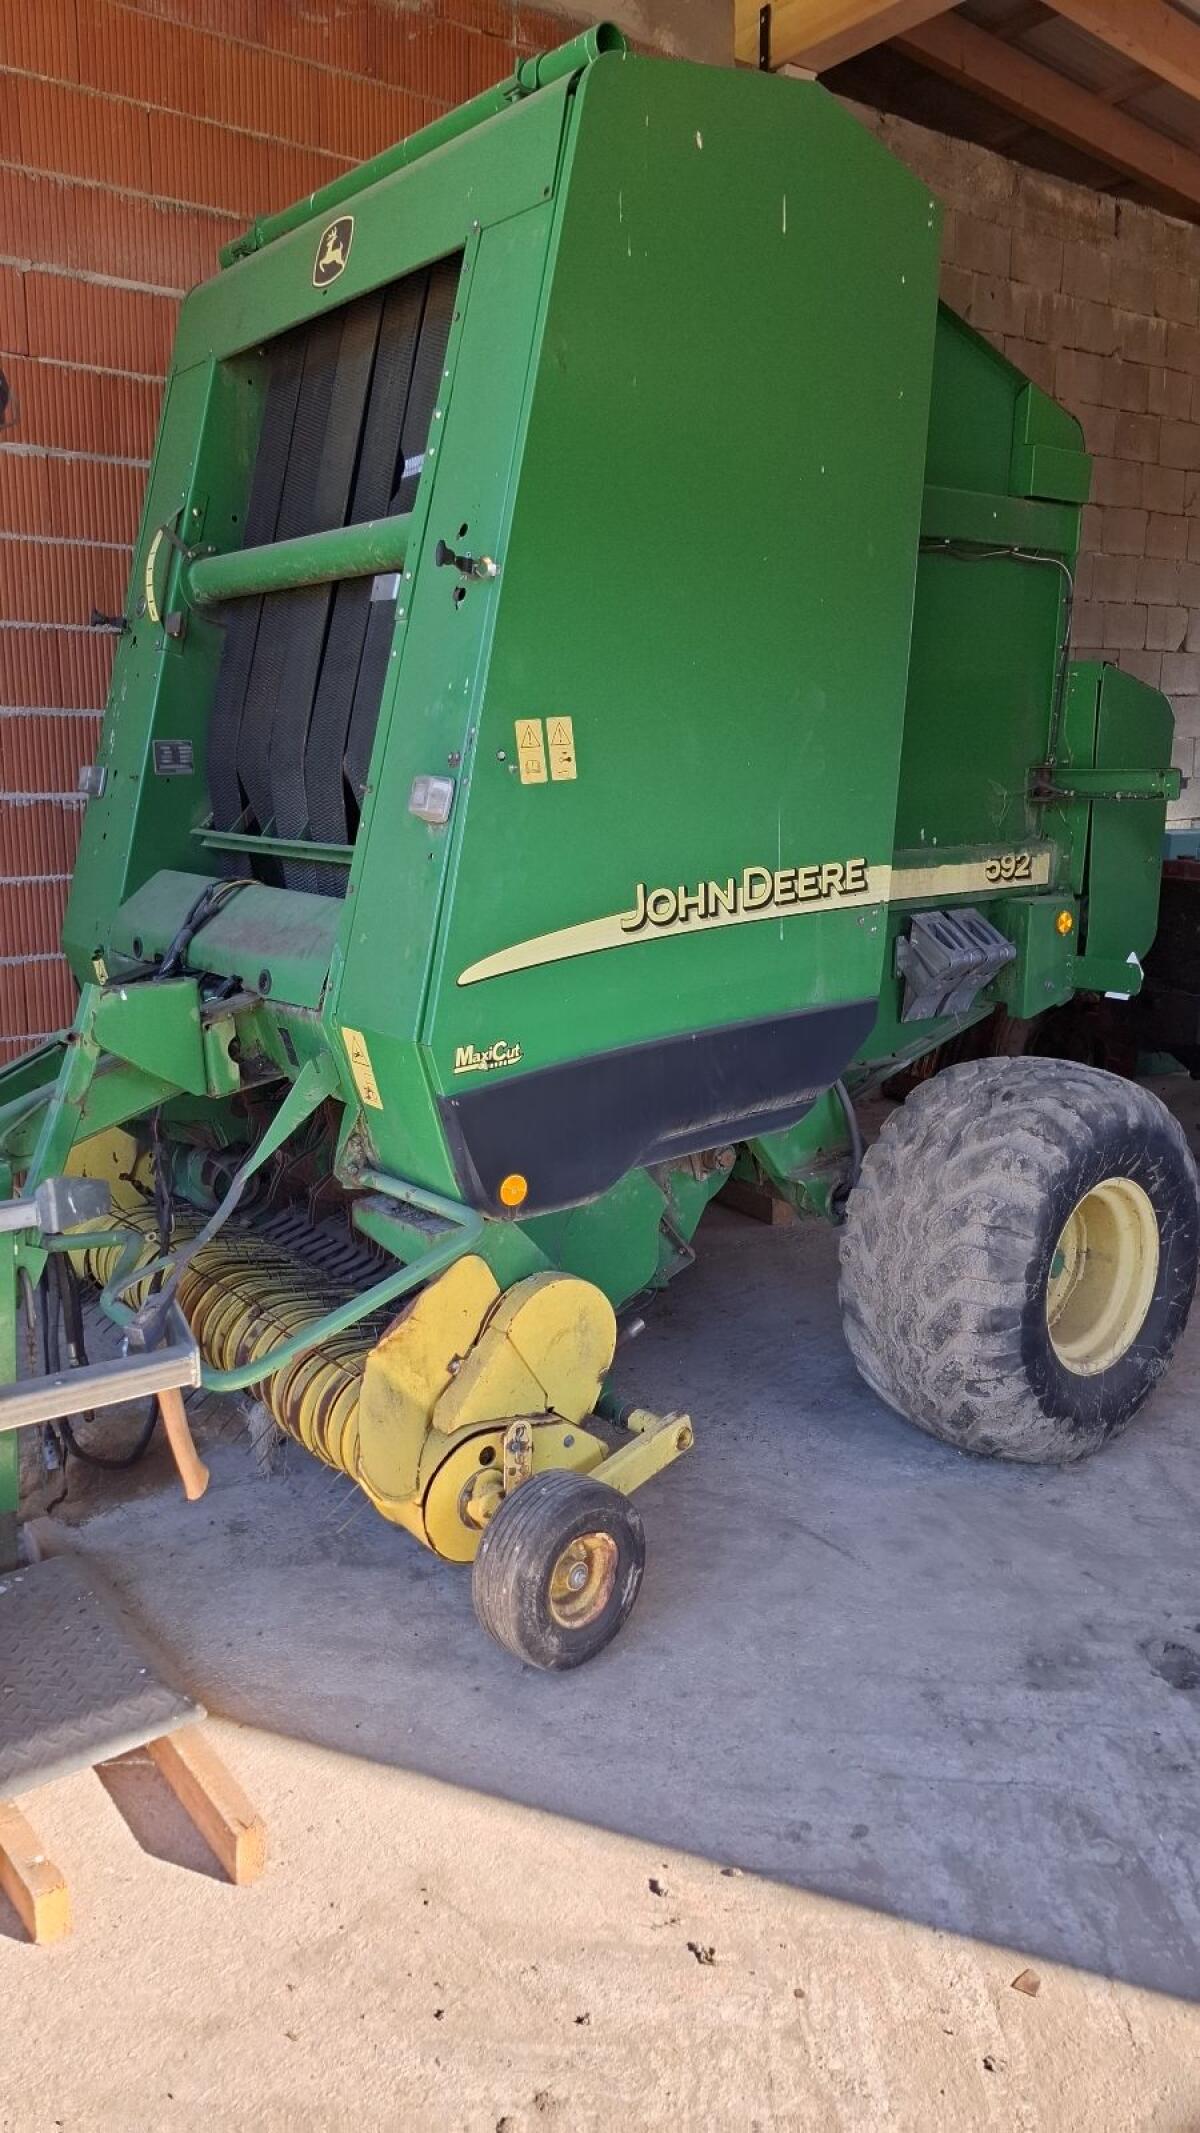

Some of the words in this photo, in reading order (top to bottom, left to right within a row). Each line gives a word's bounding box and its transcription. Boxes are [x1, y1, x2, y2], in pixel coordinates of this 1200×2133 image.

[985, 853, 1031, 882] 592
[620, 877, 737, 932] JOHN
[743, 857, 868, 912] DEERE
[454, 1040, 522, 1068] MaxiCut
